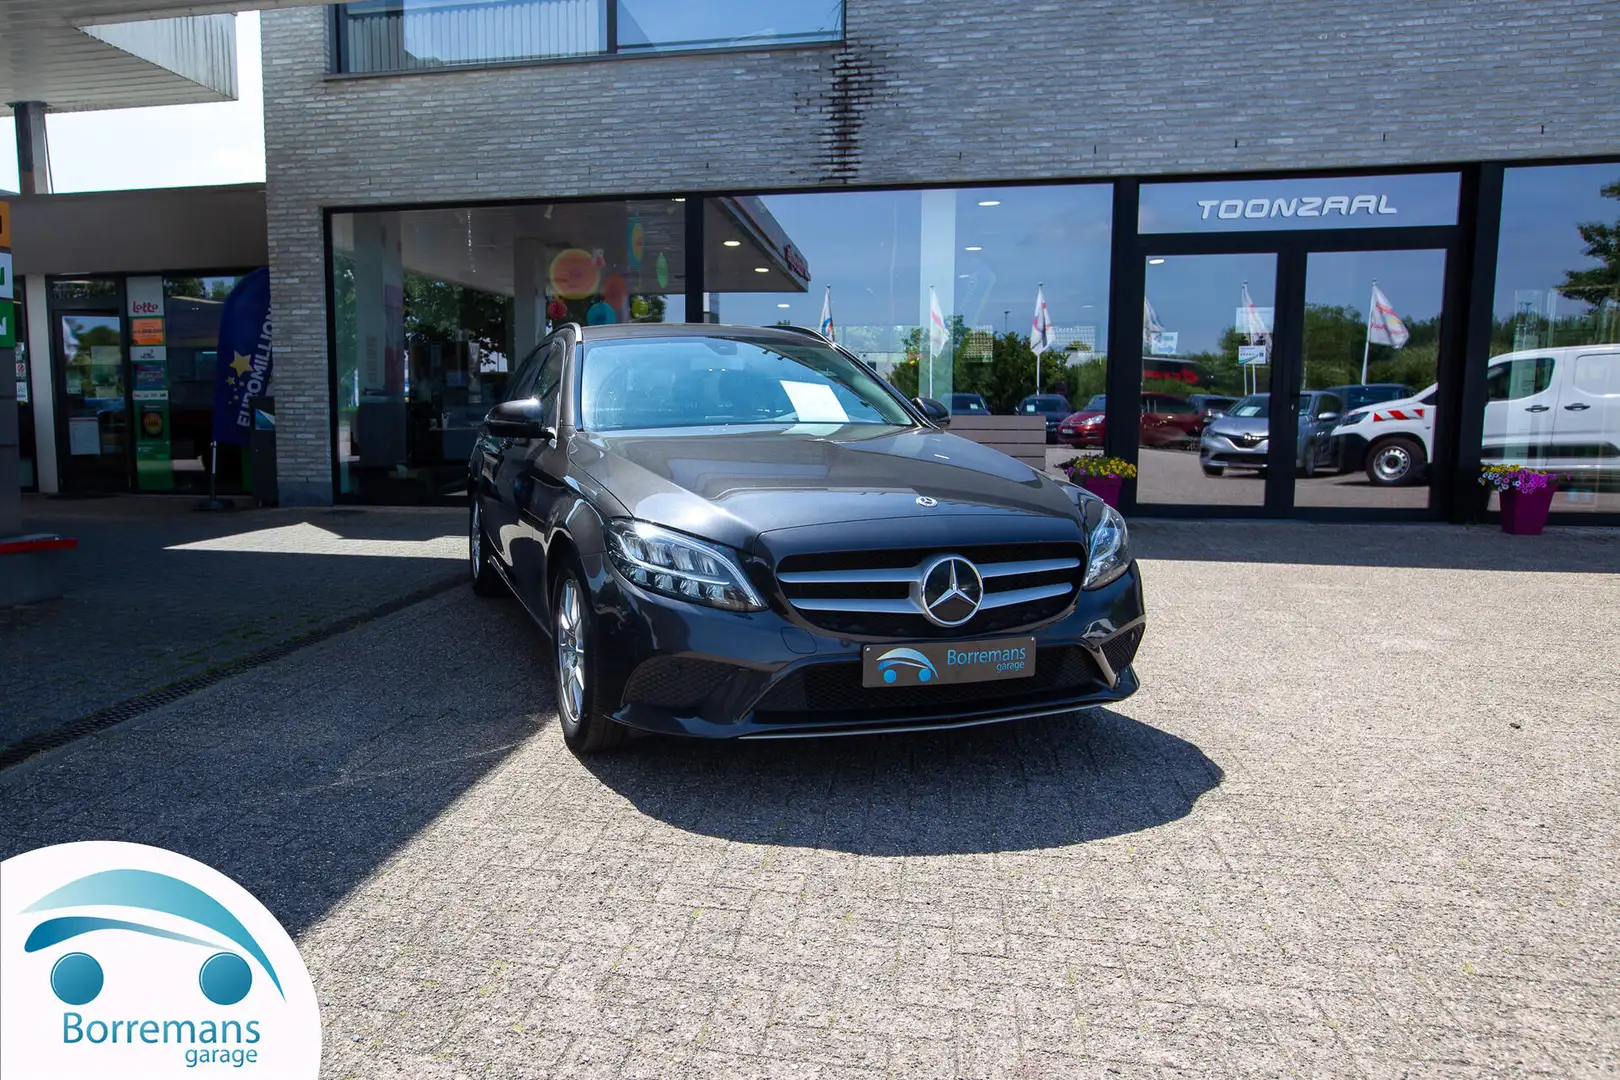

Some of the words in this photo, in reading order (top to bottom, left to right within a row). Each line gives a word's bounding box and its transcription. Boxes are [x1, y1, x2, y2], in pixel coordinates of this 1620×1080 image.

[1197, 194, 1397, 220] TOONZAAL
[947, 646, 1026, 665] Borremans
[996, 660, 1025, 673] garage
